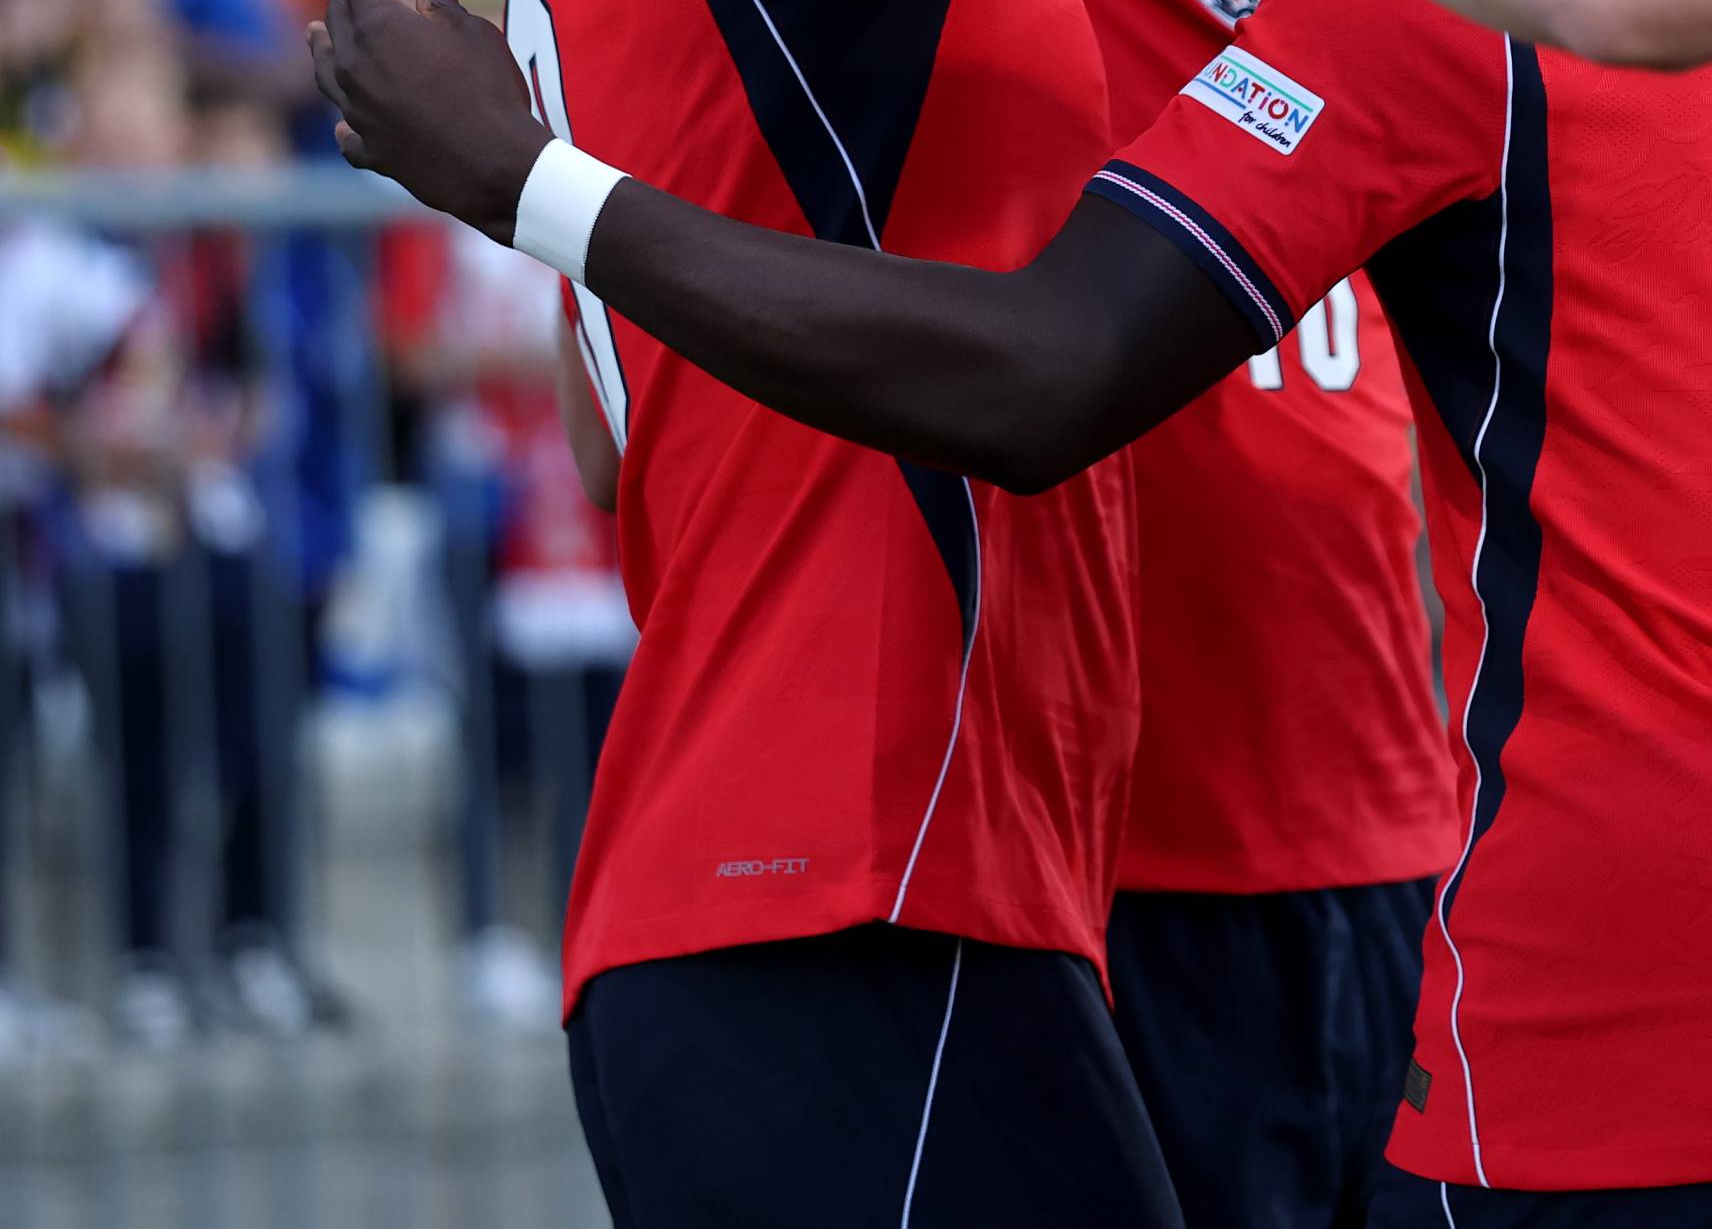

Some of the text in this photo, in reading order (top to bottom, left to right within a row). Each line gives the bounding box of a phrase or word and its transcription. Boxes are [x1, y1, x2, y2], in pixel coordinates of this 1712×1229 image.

[1238, 111, 1292, 149] for children
[1249, 275, 1360, 392] 0
[716, 857, 810, 878] AERO-FIT
